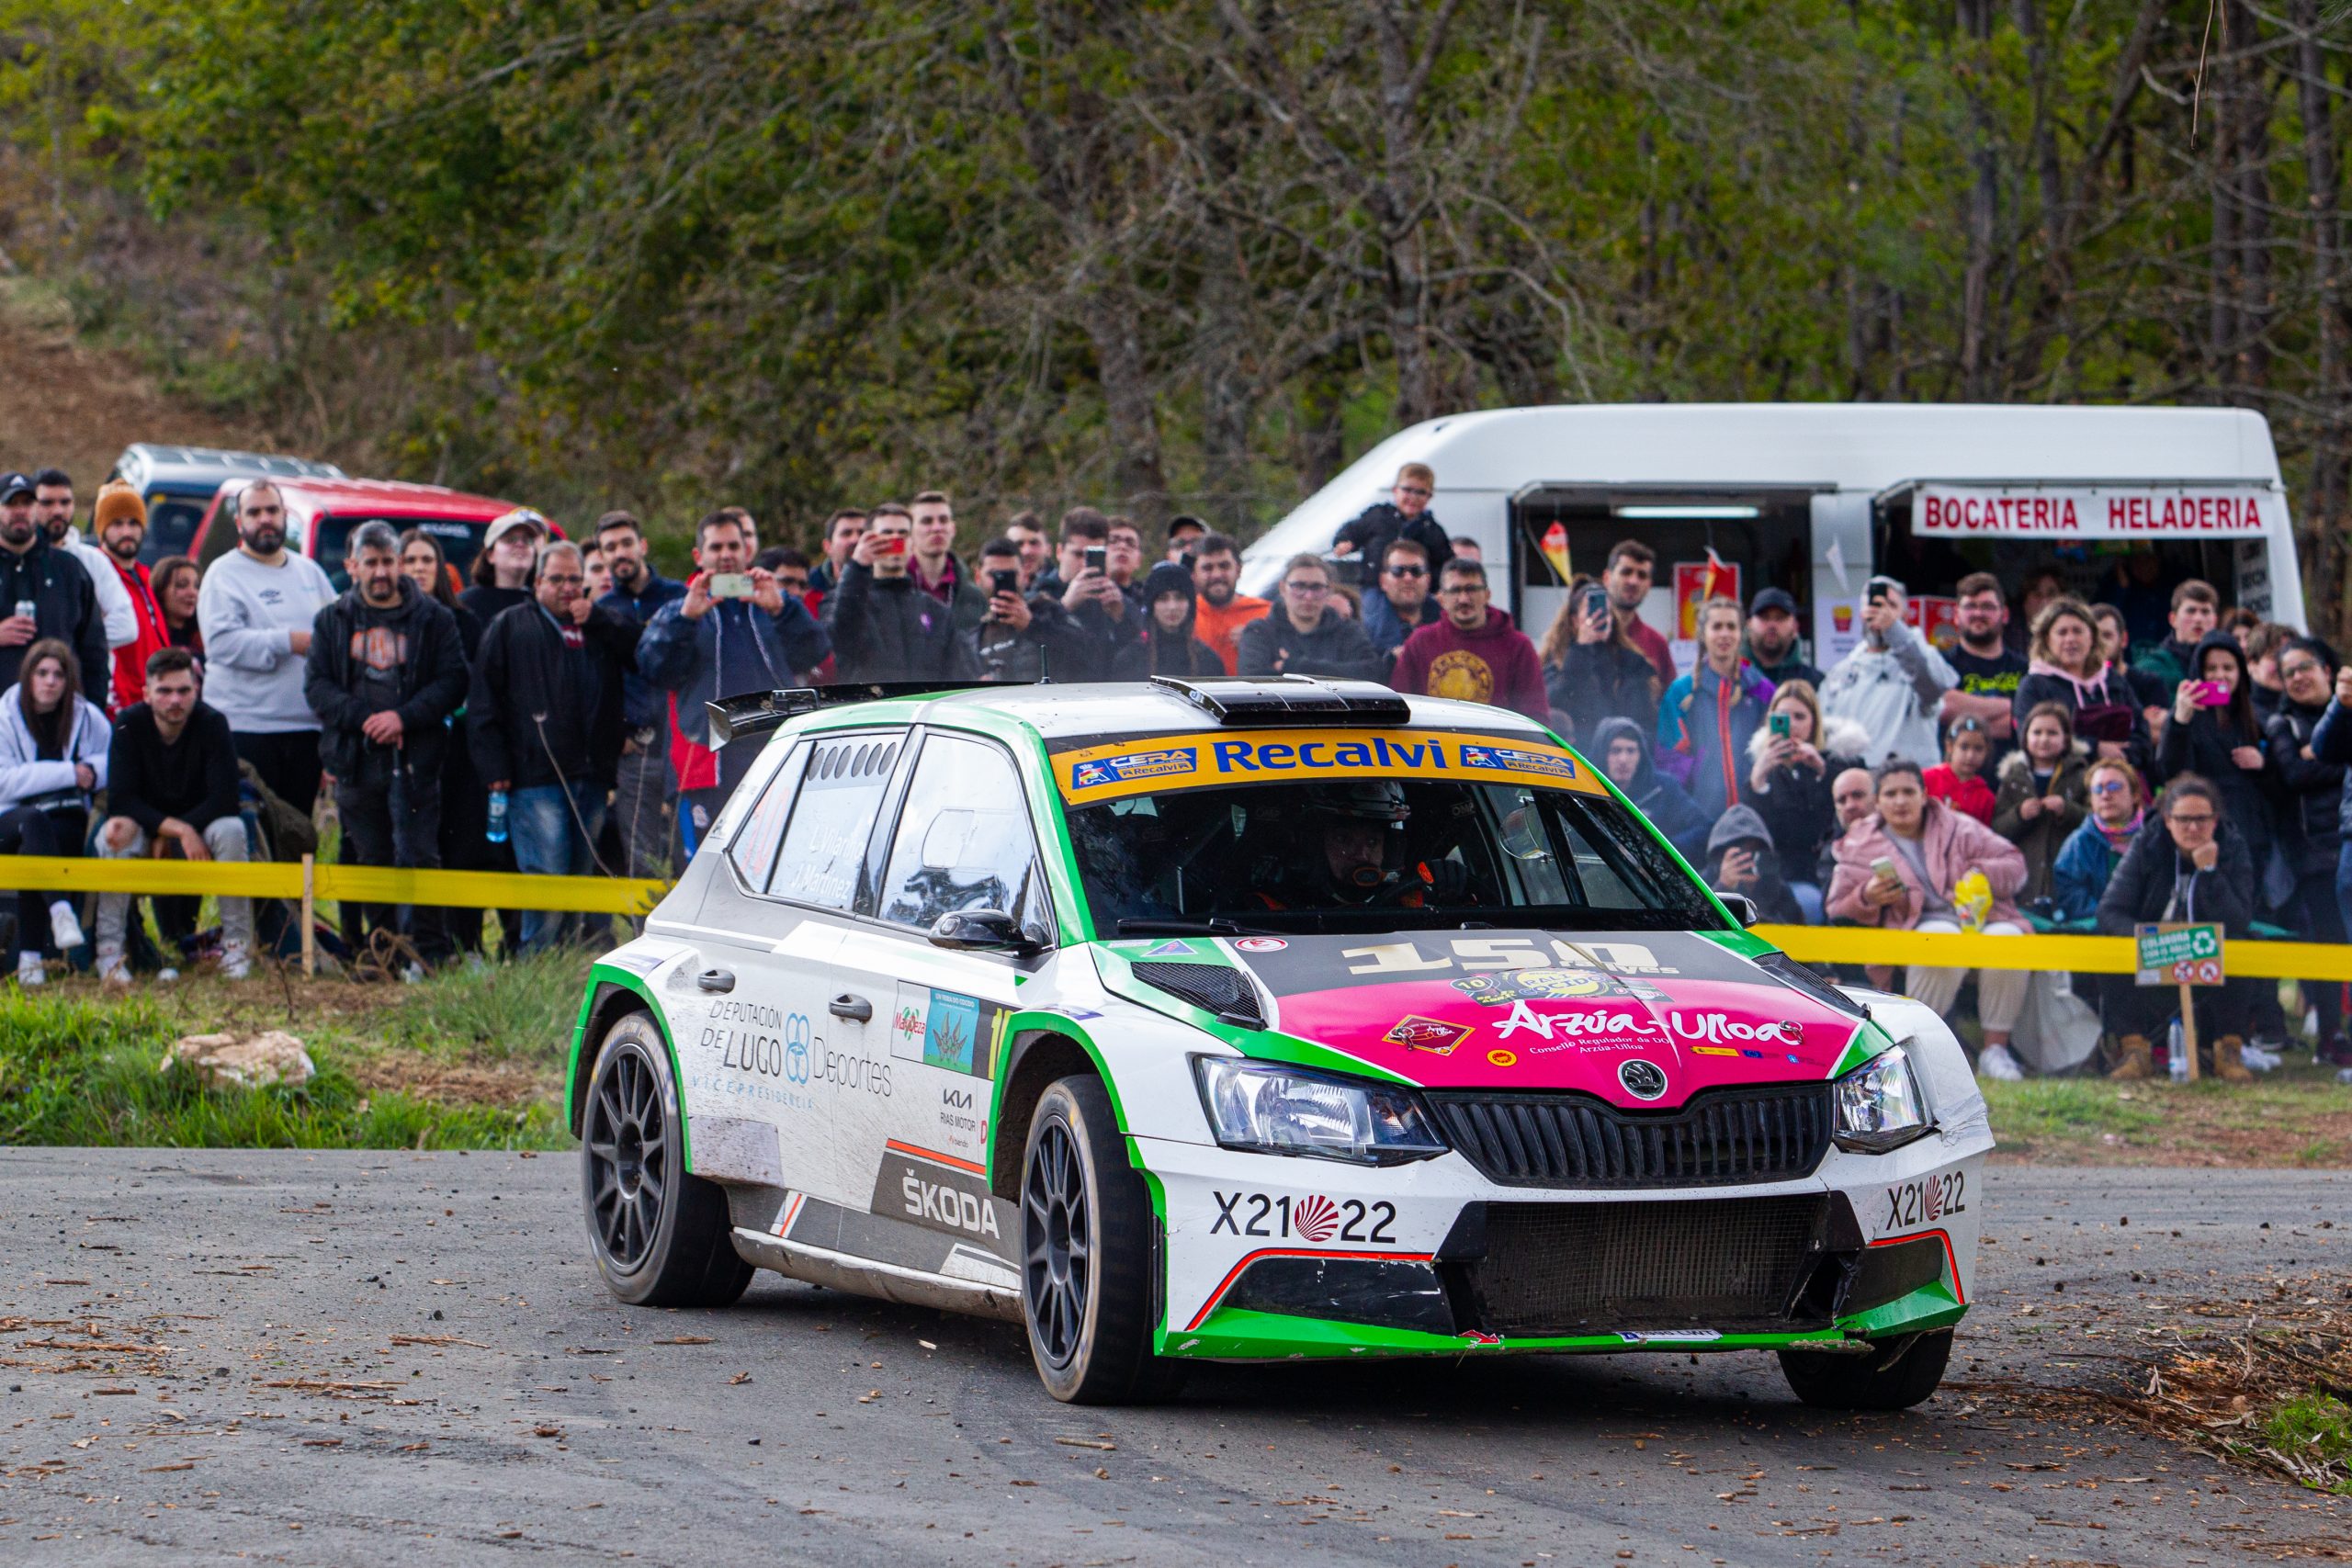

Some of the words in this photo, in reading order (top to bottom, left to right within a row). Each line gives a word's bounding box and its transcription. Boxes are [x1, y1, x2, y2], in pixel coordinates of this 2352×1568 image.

[1925, 497, 2078, 529] BOCATERIA
[2109, 497, 2262, 529] HELADERIA
[1110, 750, 1192, 768] CERA
[1210, 737, 1450, 773] Recalvi
[1494, 749, 1571, 767] CERA
[1134, 763, 1178, 776] Recalvi
[1518, 762, 1559, 774] Recalvi
[1341, 939, 1659, 976] 150
[1457, 978, 1486, 990] 10
[709, 999, 781, 1031] DEPUTACIÓN
[700, 1027, 726, 1049] DE
[723, 1028, 781, 1077] LUGO
[1529, 1041, 1576, 1055] Consello
[1579, 1036, 1633, 1047] Regulador
[1637, 1035, 1651, 1044] da
[1579, 1043, 1645, 1054] Arzúa-Ulloa
[814, 1036, 891, 1098] Deportes
[955, 1115, 976, 1133] MOTOR
[902, 1168, 1001, 1240] ŠKODA
